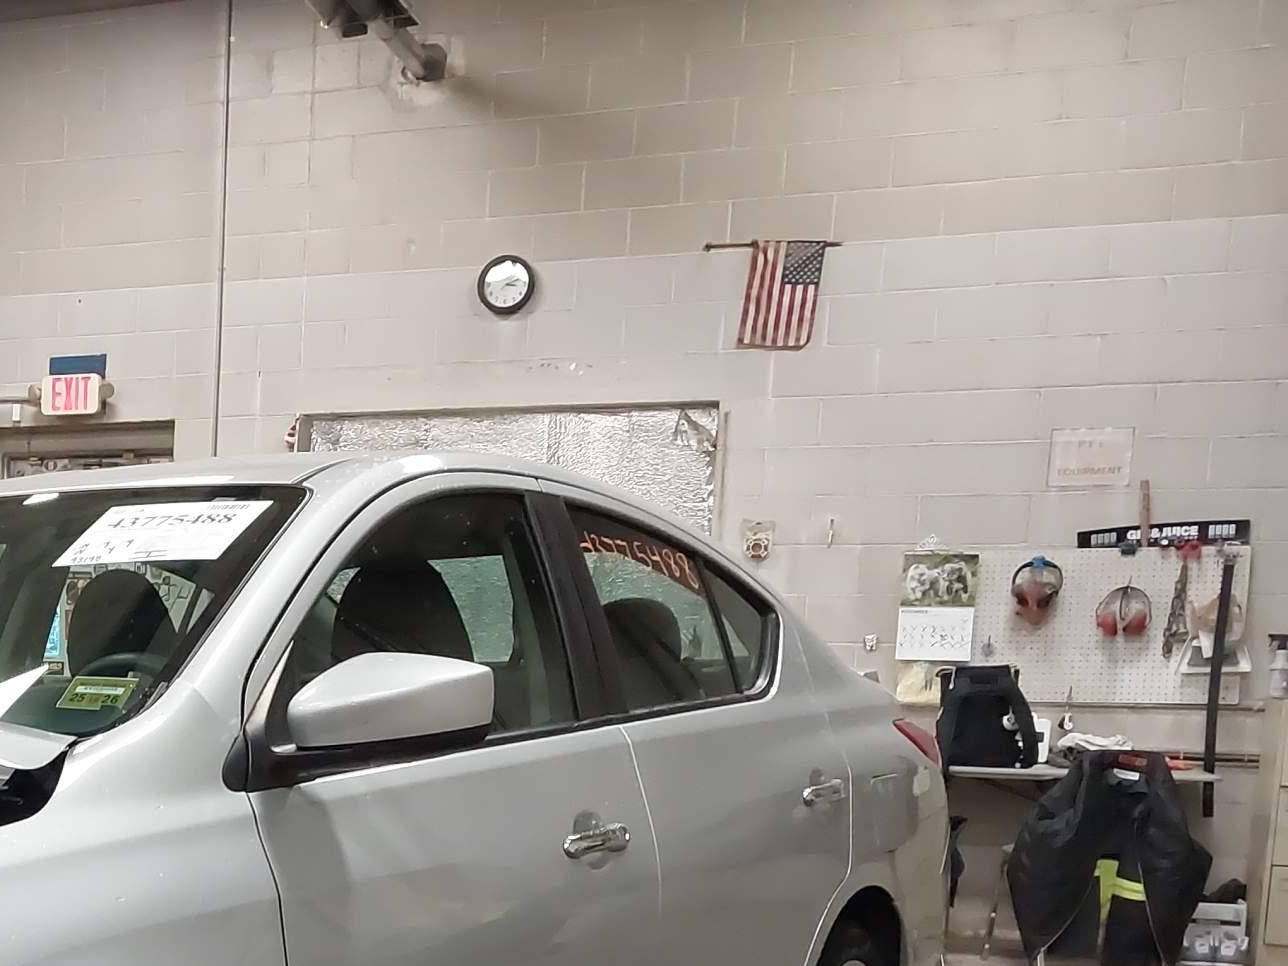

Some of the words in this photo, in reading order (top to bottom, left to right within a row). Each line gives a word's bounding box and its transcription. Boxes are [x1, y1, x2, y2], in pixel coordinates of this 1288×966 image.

[52, 376, 92, 411] EXIT
[107, 513, 237, 529] 43775488
[1161, 525, 1199, 538] JUICE
[69, 693, 86, 703] 25
[101, 695, 119, 705] 26
